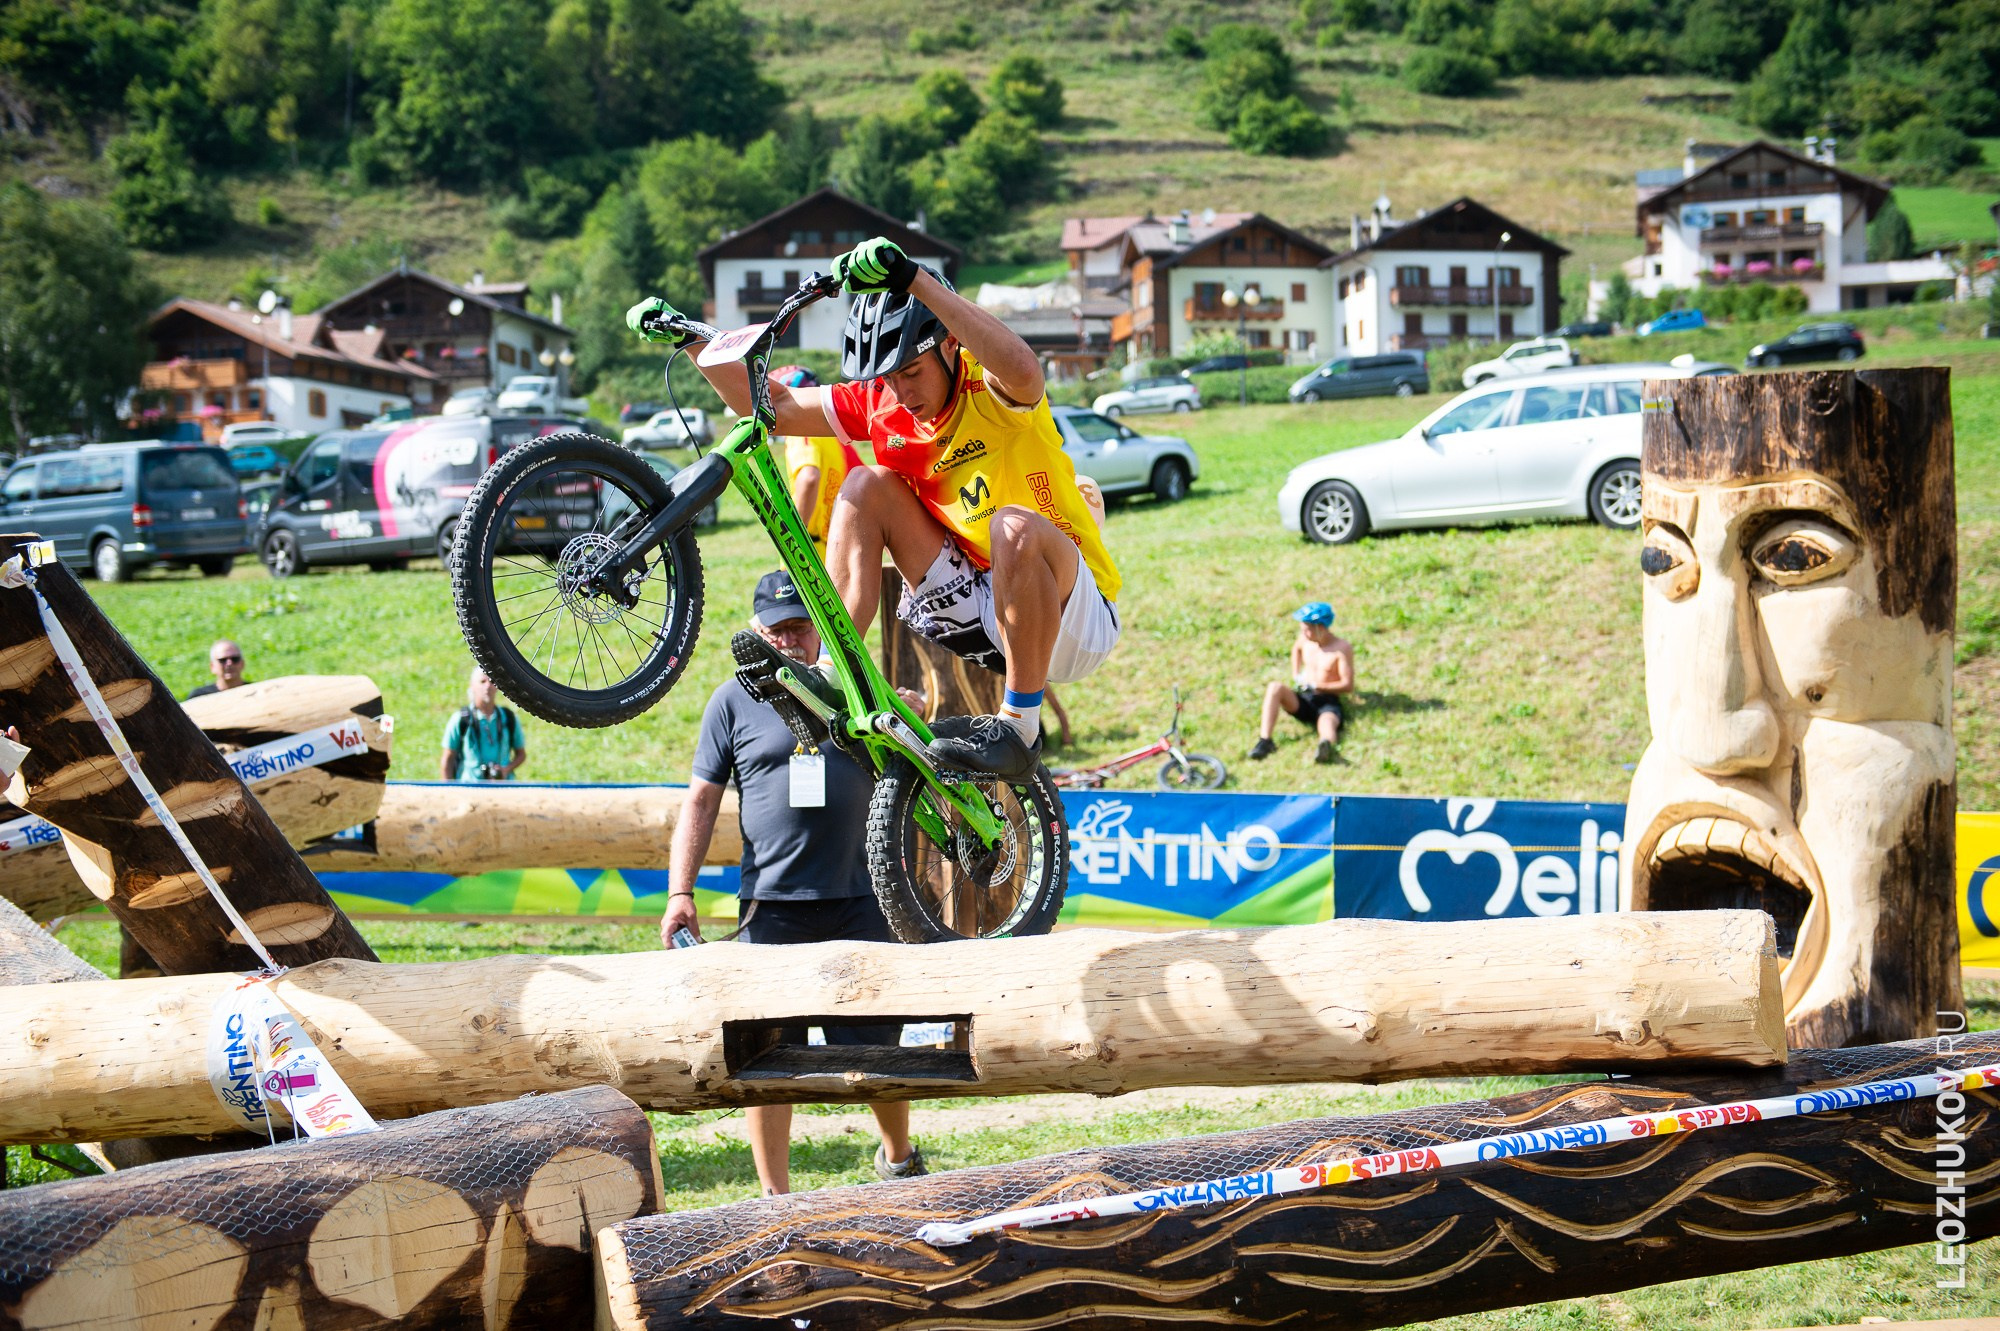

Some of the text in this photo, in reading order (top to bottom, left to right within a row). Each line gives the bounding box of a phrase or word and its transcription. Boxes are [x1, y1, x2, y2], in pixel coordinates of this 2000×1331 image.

[965, 505, 998, 524] movistar
[678, 598, 694, 655] MONTY
[647, 665, 672, 691] RACE
[230, 729, 360, 780] TRENTINO Val
[1032, 773, 1056, 817] ONTY
[1052, 834, 1061, 877] RACE
[1068, 822, 1281, 887] RENTINO
[1795, 1080, 1917, 1116] TRENTINO
[1478, 1124, 1608, 1162] TRENTINO
